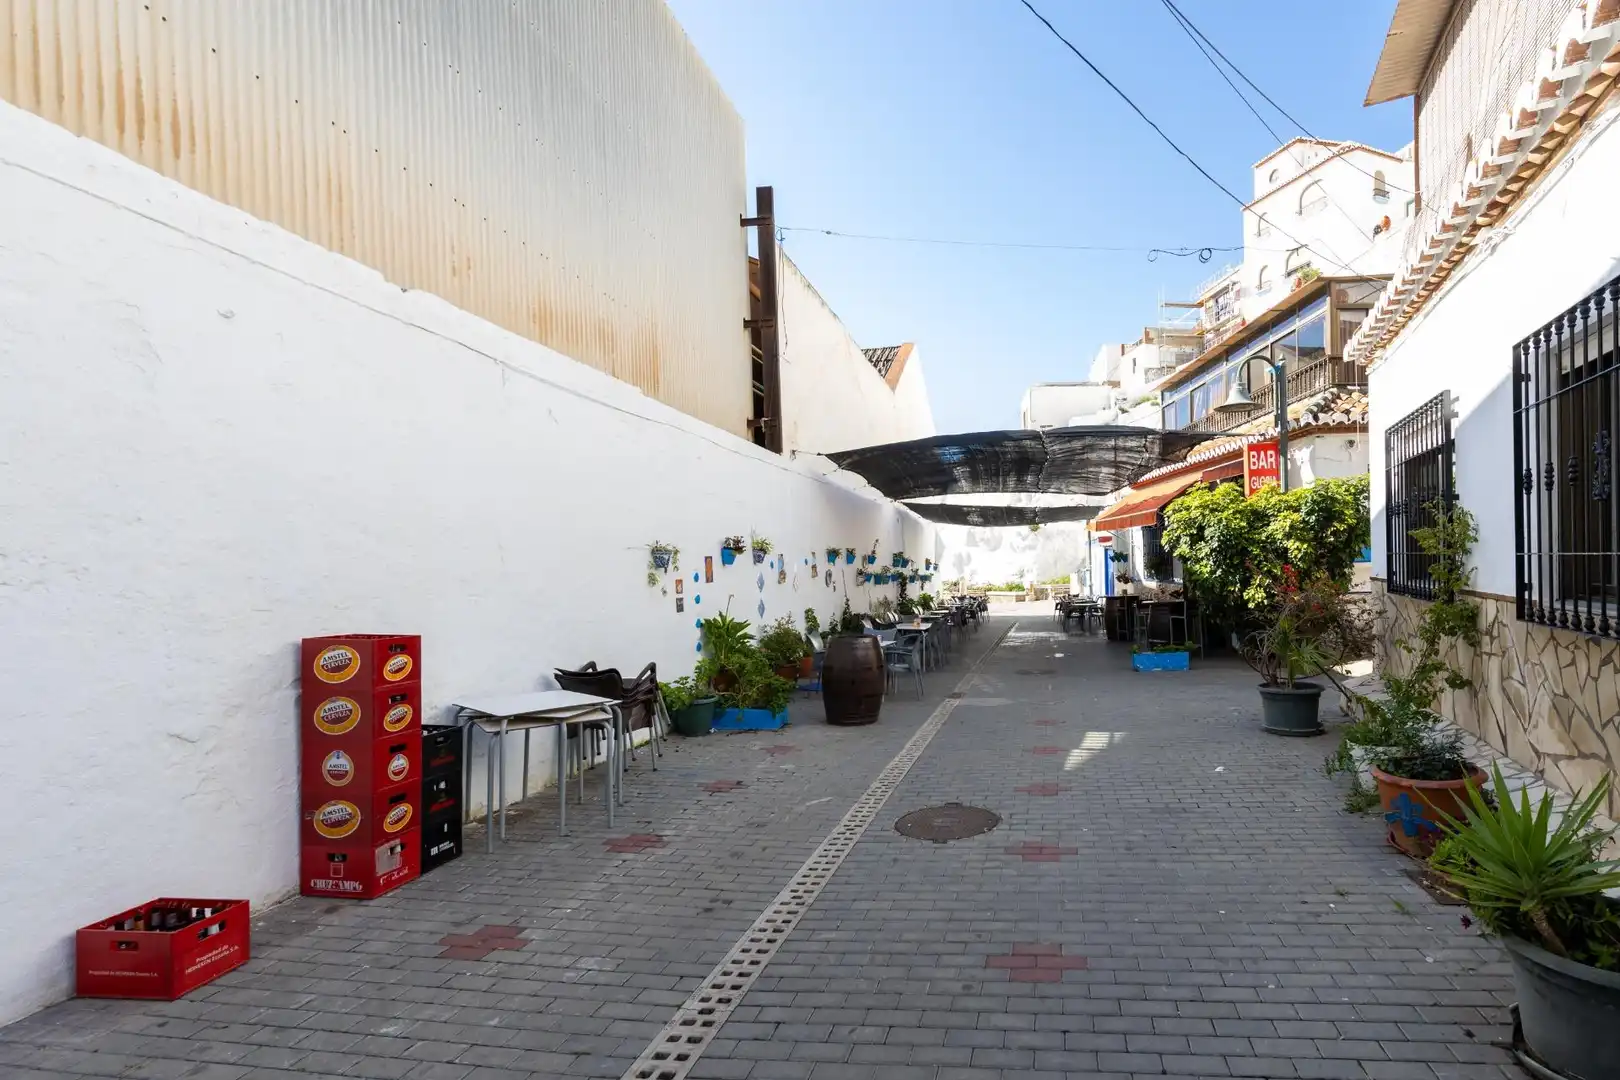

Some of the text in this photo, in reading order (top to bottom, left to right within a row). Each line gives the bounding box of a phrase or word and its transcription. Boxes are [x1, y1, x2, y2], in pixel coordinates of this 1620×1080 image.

[1250, 450, 1276, 470] BAR
[322, 651, 350, 664] AMSTEL
[323, 659, 351, 670] CERVEZA
[322, 702, 350, 715] AMSTEL
[323, 711, 351, 722] CERVEZA
[322, 807, 349, 818] AMSTEL
